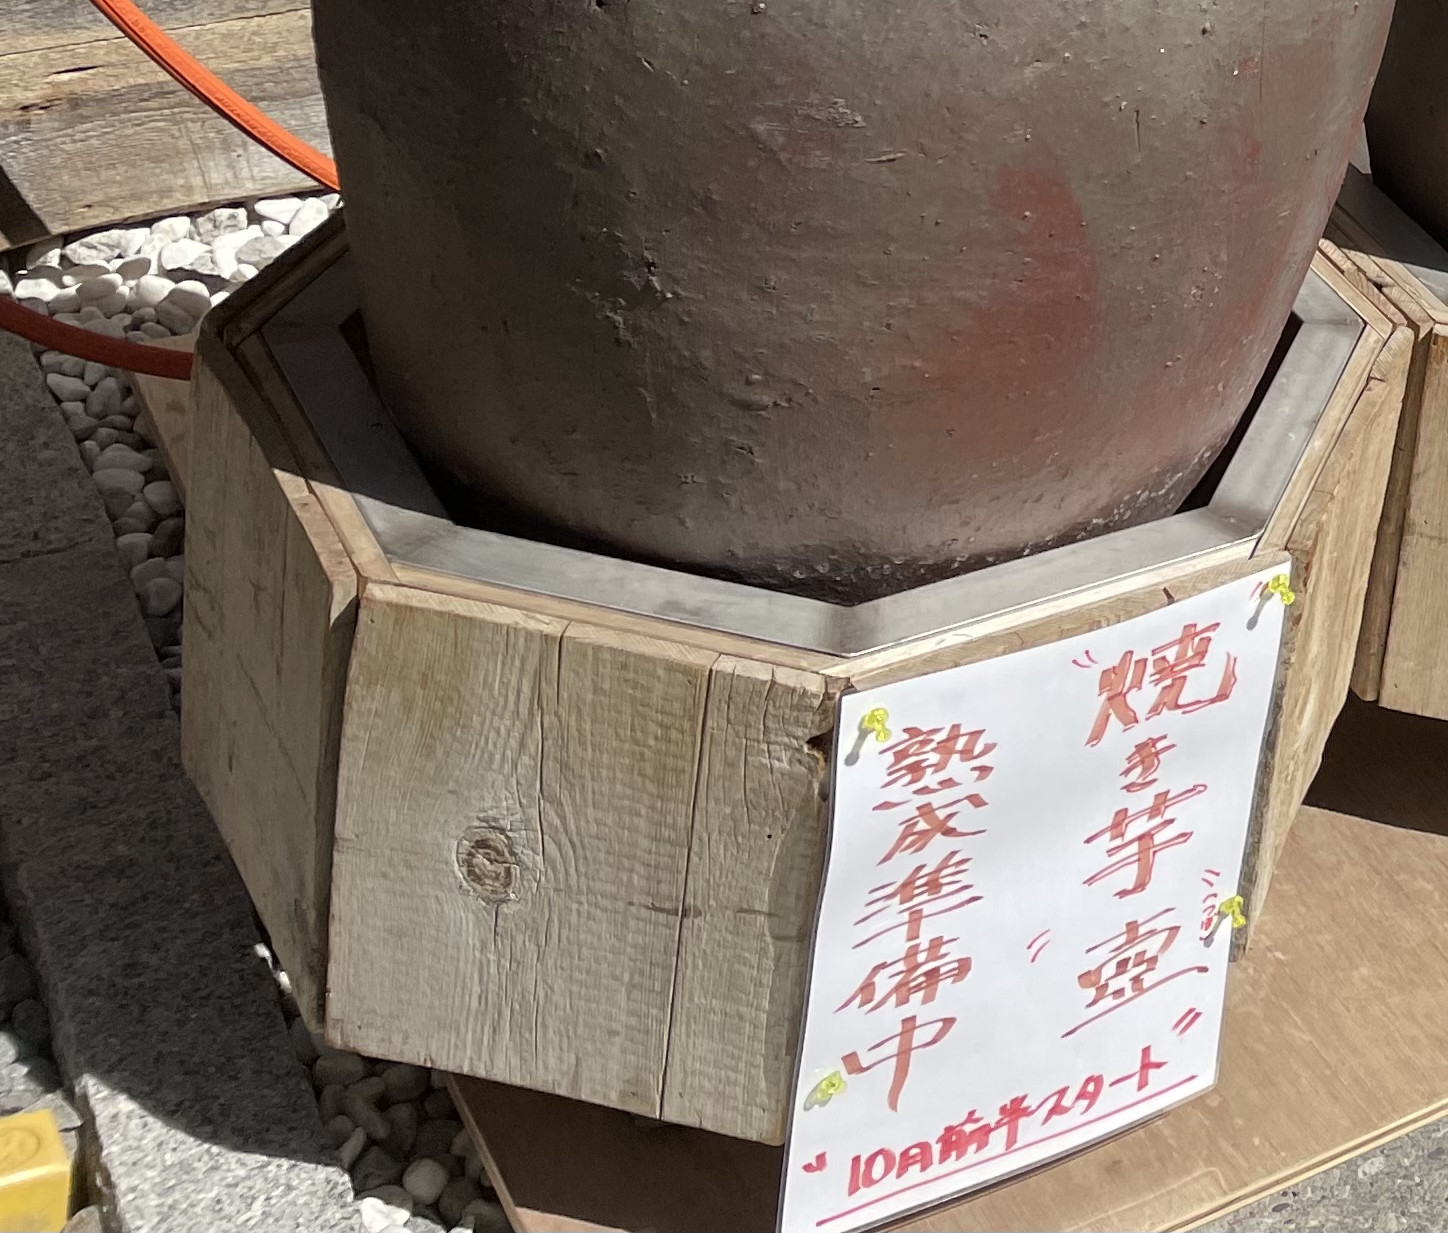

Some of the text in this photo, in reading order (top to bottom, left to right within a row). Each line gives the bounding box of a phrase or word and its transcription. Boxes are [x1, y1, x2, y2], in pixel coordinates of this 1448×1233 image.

[834, 723, 998, 1112] 熟成準備中
